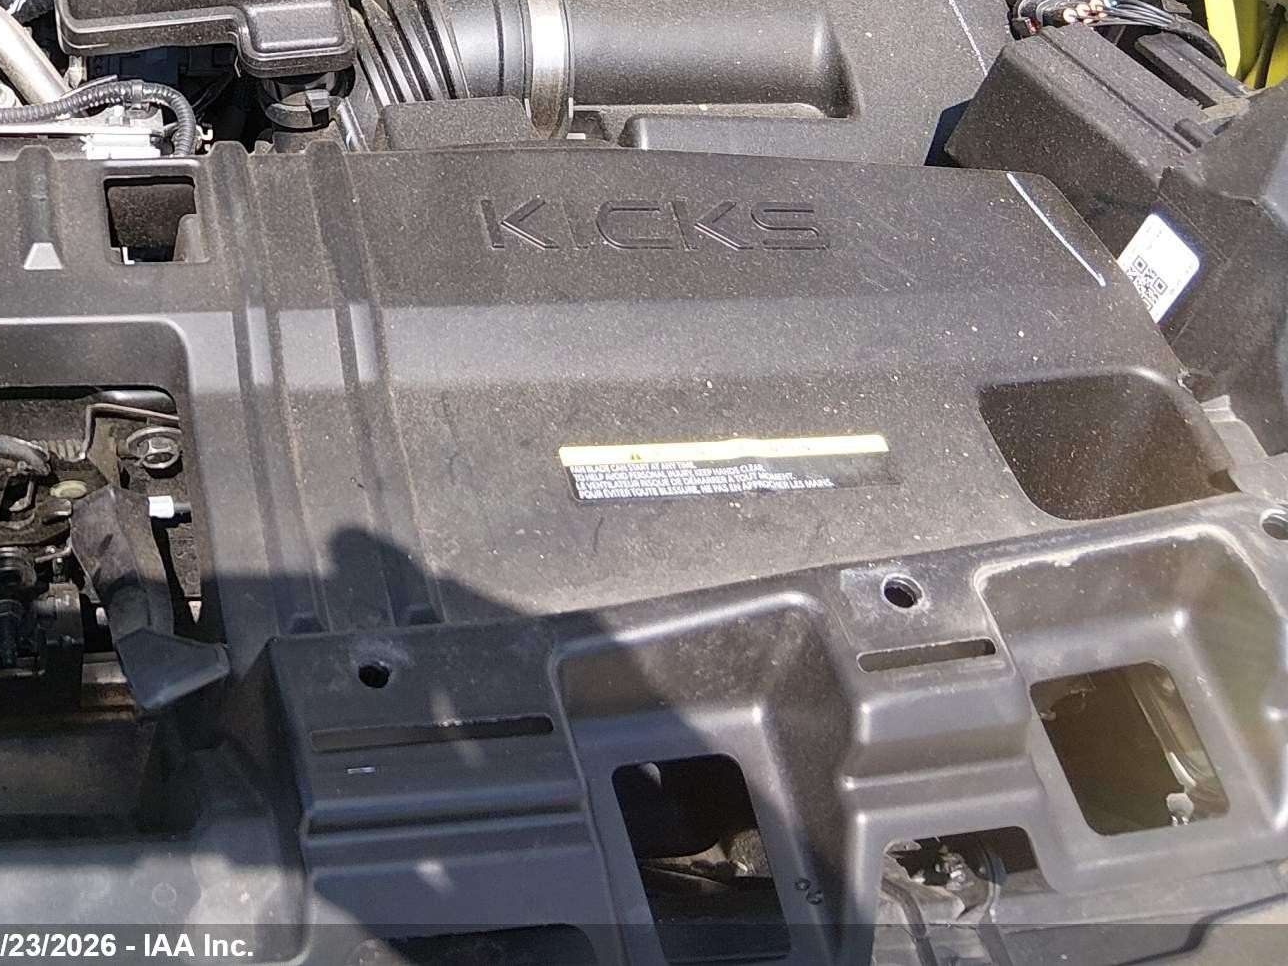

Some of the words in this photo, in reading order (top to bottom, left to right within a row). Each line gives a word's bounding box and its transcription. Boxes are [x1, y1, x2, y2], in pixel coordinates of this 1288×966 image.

[476, 196, 832, 251] KICKS
[573, 473, 585, 482] TO
[585, 472, 604, 482] HELP
[604, 472, 629, 481] AVOID
[629, 470, 667, 480] PERSONAL
[693, 467, 712, 477] KEEP
[712, 466, 740, 475] HANDS
[610, 463, 627, 472] CAN
[627, 462, 650, 471] START
[650, 461, 660, 470] AT
[661, 461, 677, 470] ANY
[576, 481, 586, 491] LE
[734, 471, 758, 482] TOUT
[579, 489, 604, 499] POUR
[632, 486, 659, 497] TOUTE
[700, 483, 713, 494] NE
[712, 482, 730, 493] PAS
[728, 481, 743, 492] EN
[742, 480, 790, 490] APPROCHER
[789, 479, 805, 489] LES
